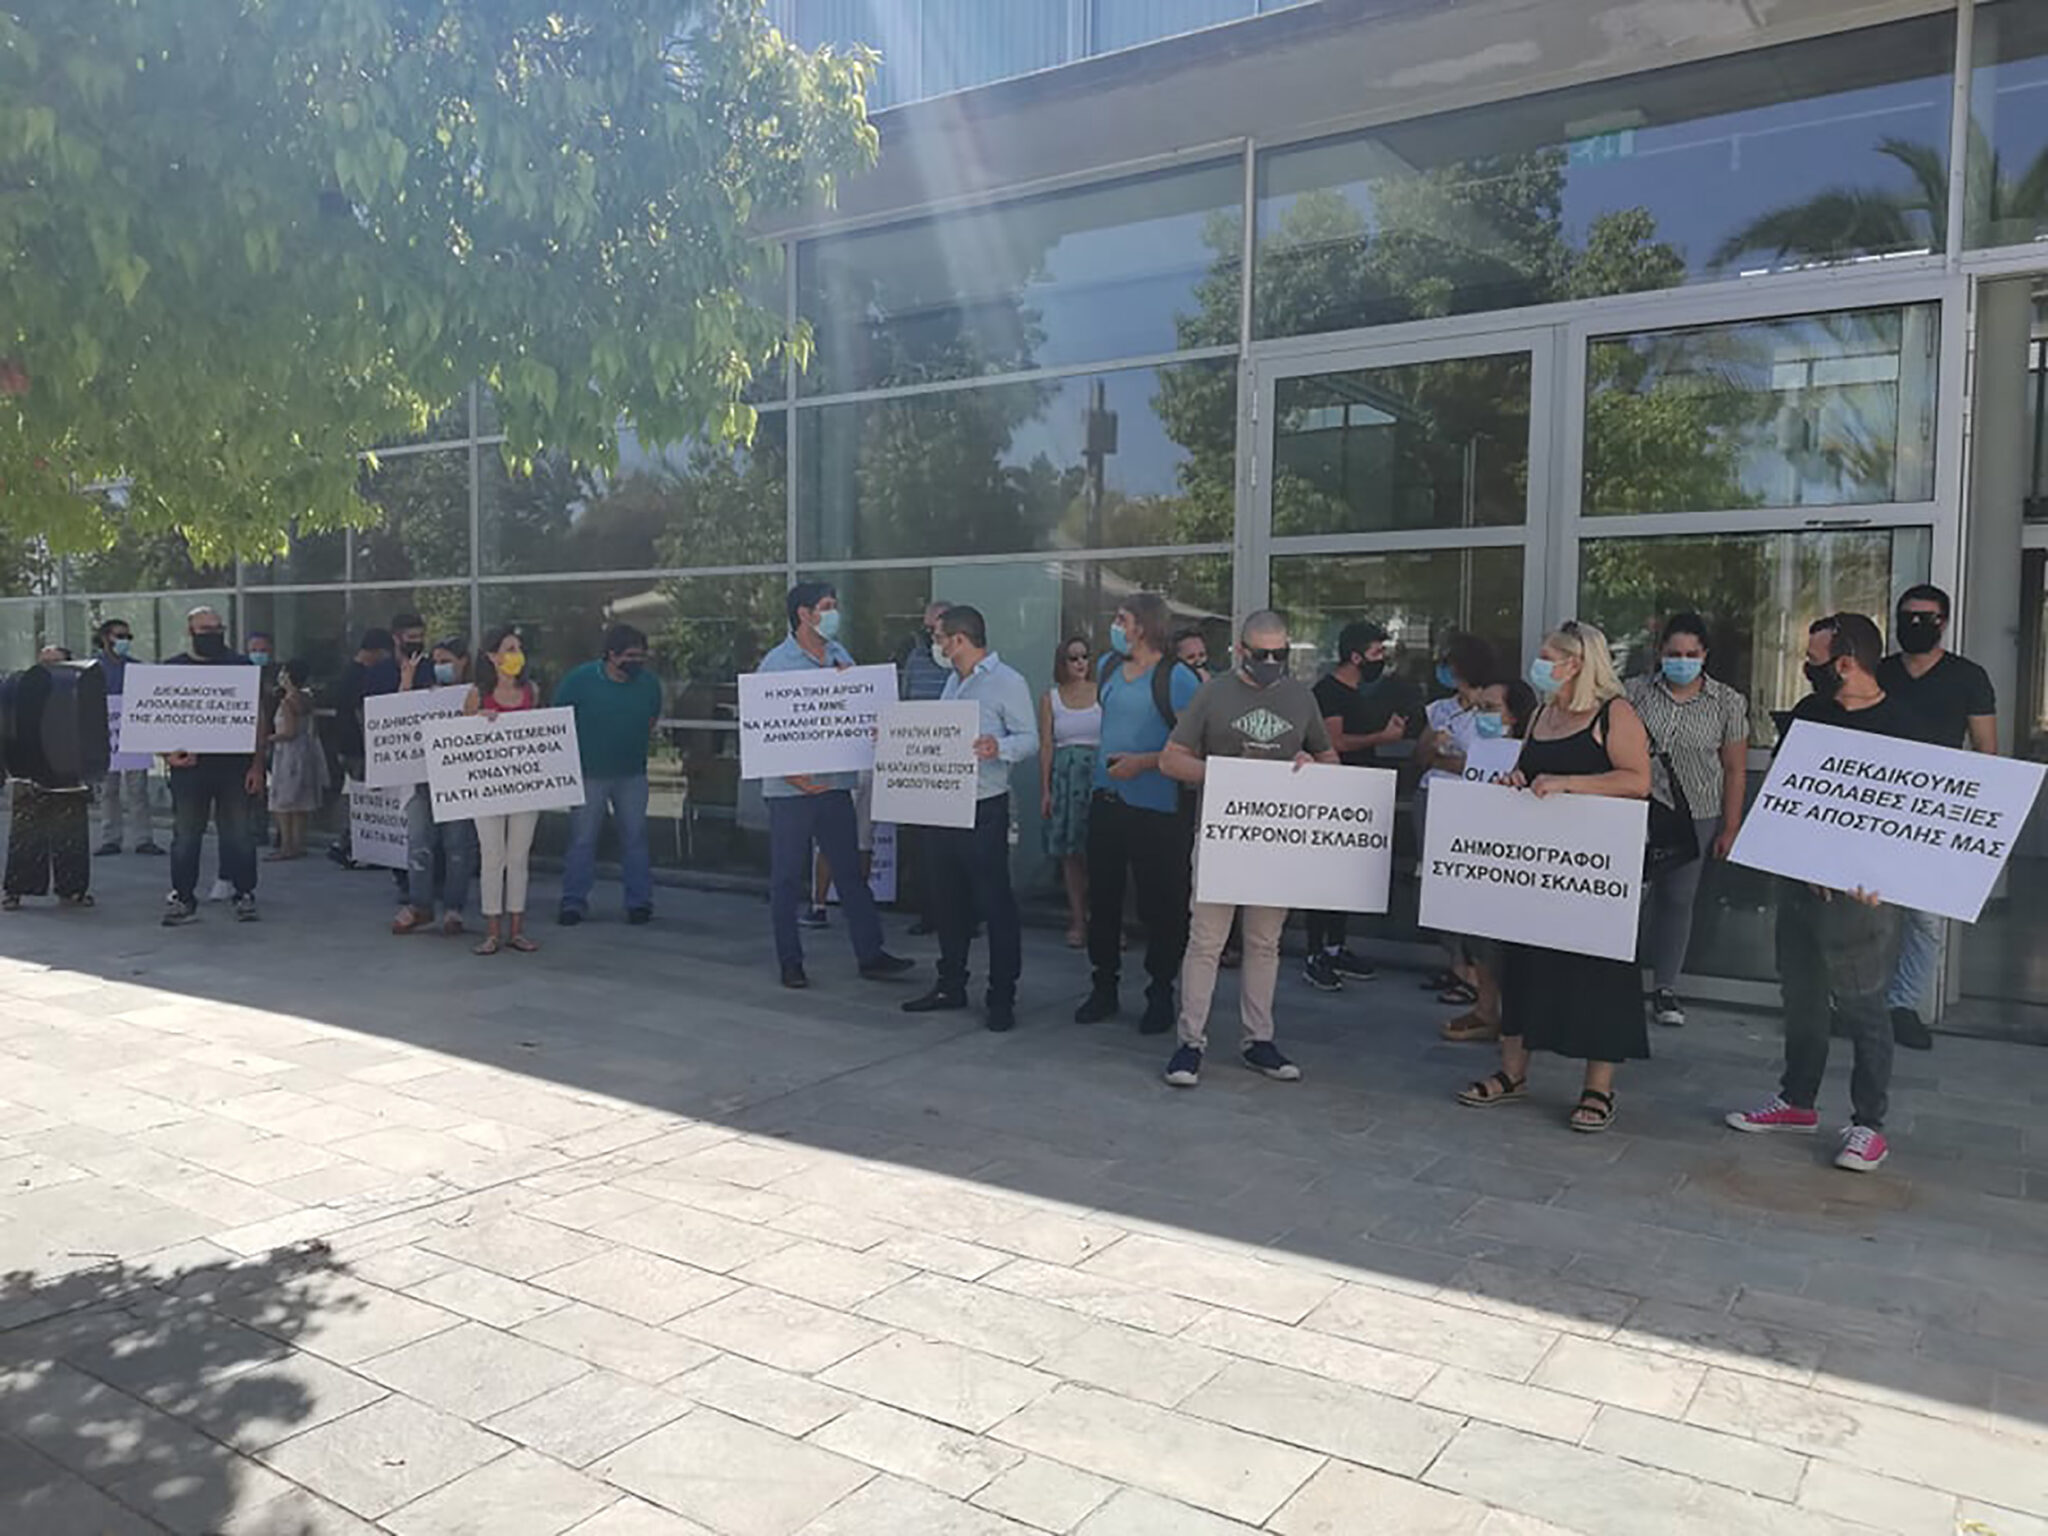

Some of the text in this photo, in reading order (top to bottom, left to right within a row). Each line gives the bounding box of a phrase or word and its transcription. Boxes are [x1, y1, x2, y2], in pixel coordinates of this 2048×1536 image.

[432, 724, 567, 750] ΑΠΟΔΕΚΑΤΙΣΜΕΝΗ
[442, 741, 562, 766] ΔΗΜΟΣΙΟΓΡΑΦΙΑ
[468, 761, 542, 782] ΚΙΝΔΥΝΟΣ
[1465, 767, 1484, 782] ΟΙ
[1819, 755, 1981, 799] ΔΙΕΚΔΙΚΟΥΜΕ
[482, 774, 577, 798] ΔΗΜΟΚΡΑΤΙΑ
[1225, 800, 1374, 824] ΔΗΜΟΣΙΟΓΡΑΦΟΙ
[1782, 773, 2004, 829] ΑΠΟΛΑΒΕΣ ΙΣΑΞΙΕΣ
[1206, 823, 1389, 849] ΣΥΓΧΡΟΝΟΙ ΣΚΛΑΒΟΙ
[1763, 793, 2006, 859] ΤΗΣ ΑΠΟΣΤΟΛΗΣ ΜΑΣ
[1450, 838, 1611, 871] ΔΗΜΟΣΙΟΓΡΑΦΟΙ
[1432, 860, 1629, 899] ΣΥΓΧΡΟΝΟΙ ΣΚΛΑΒΟΙ
